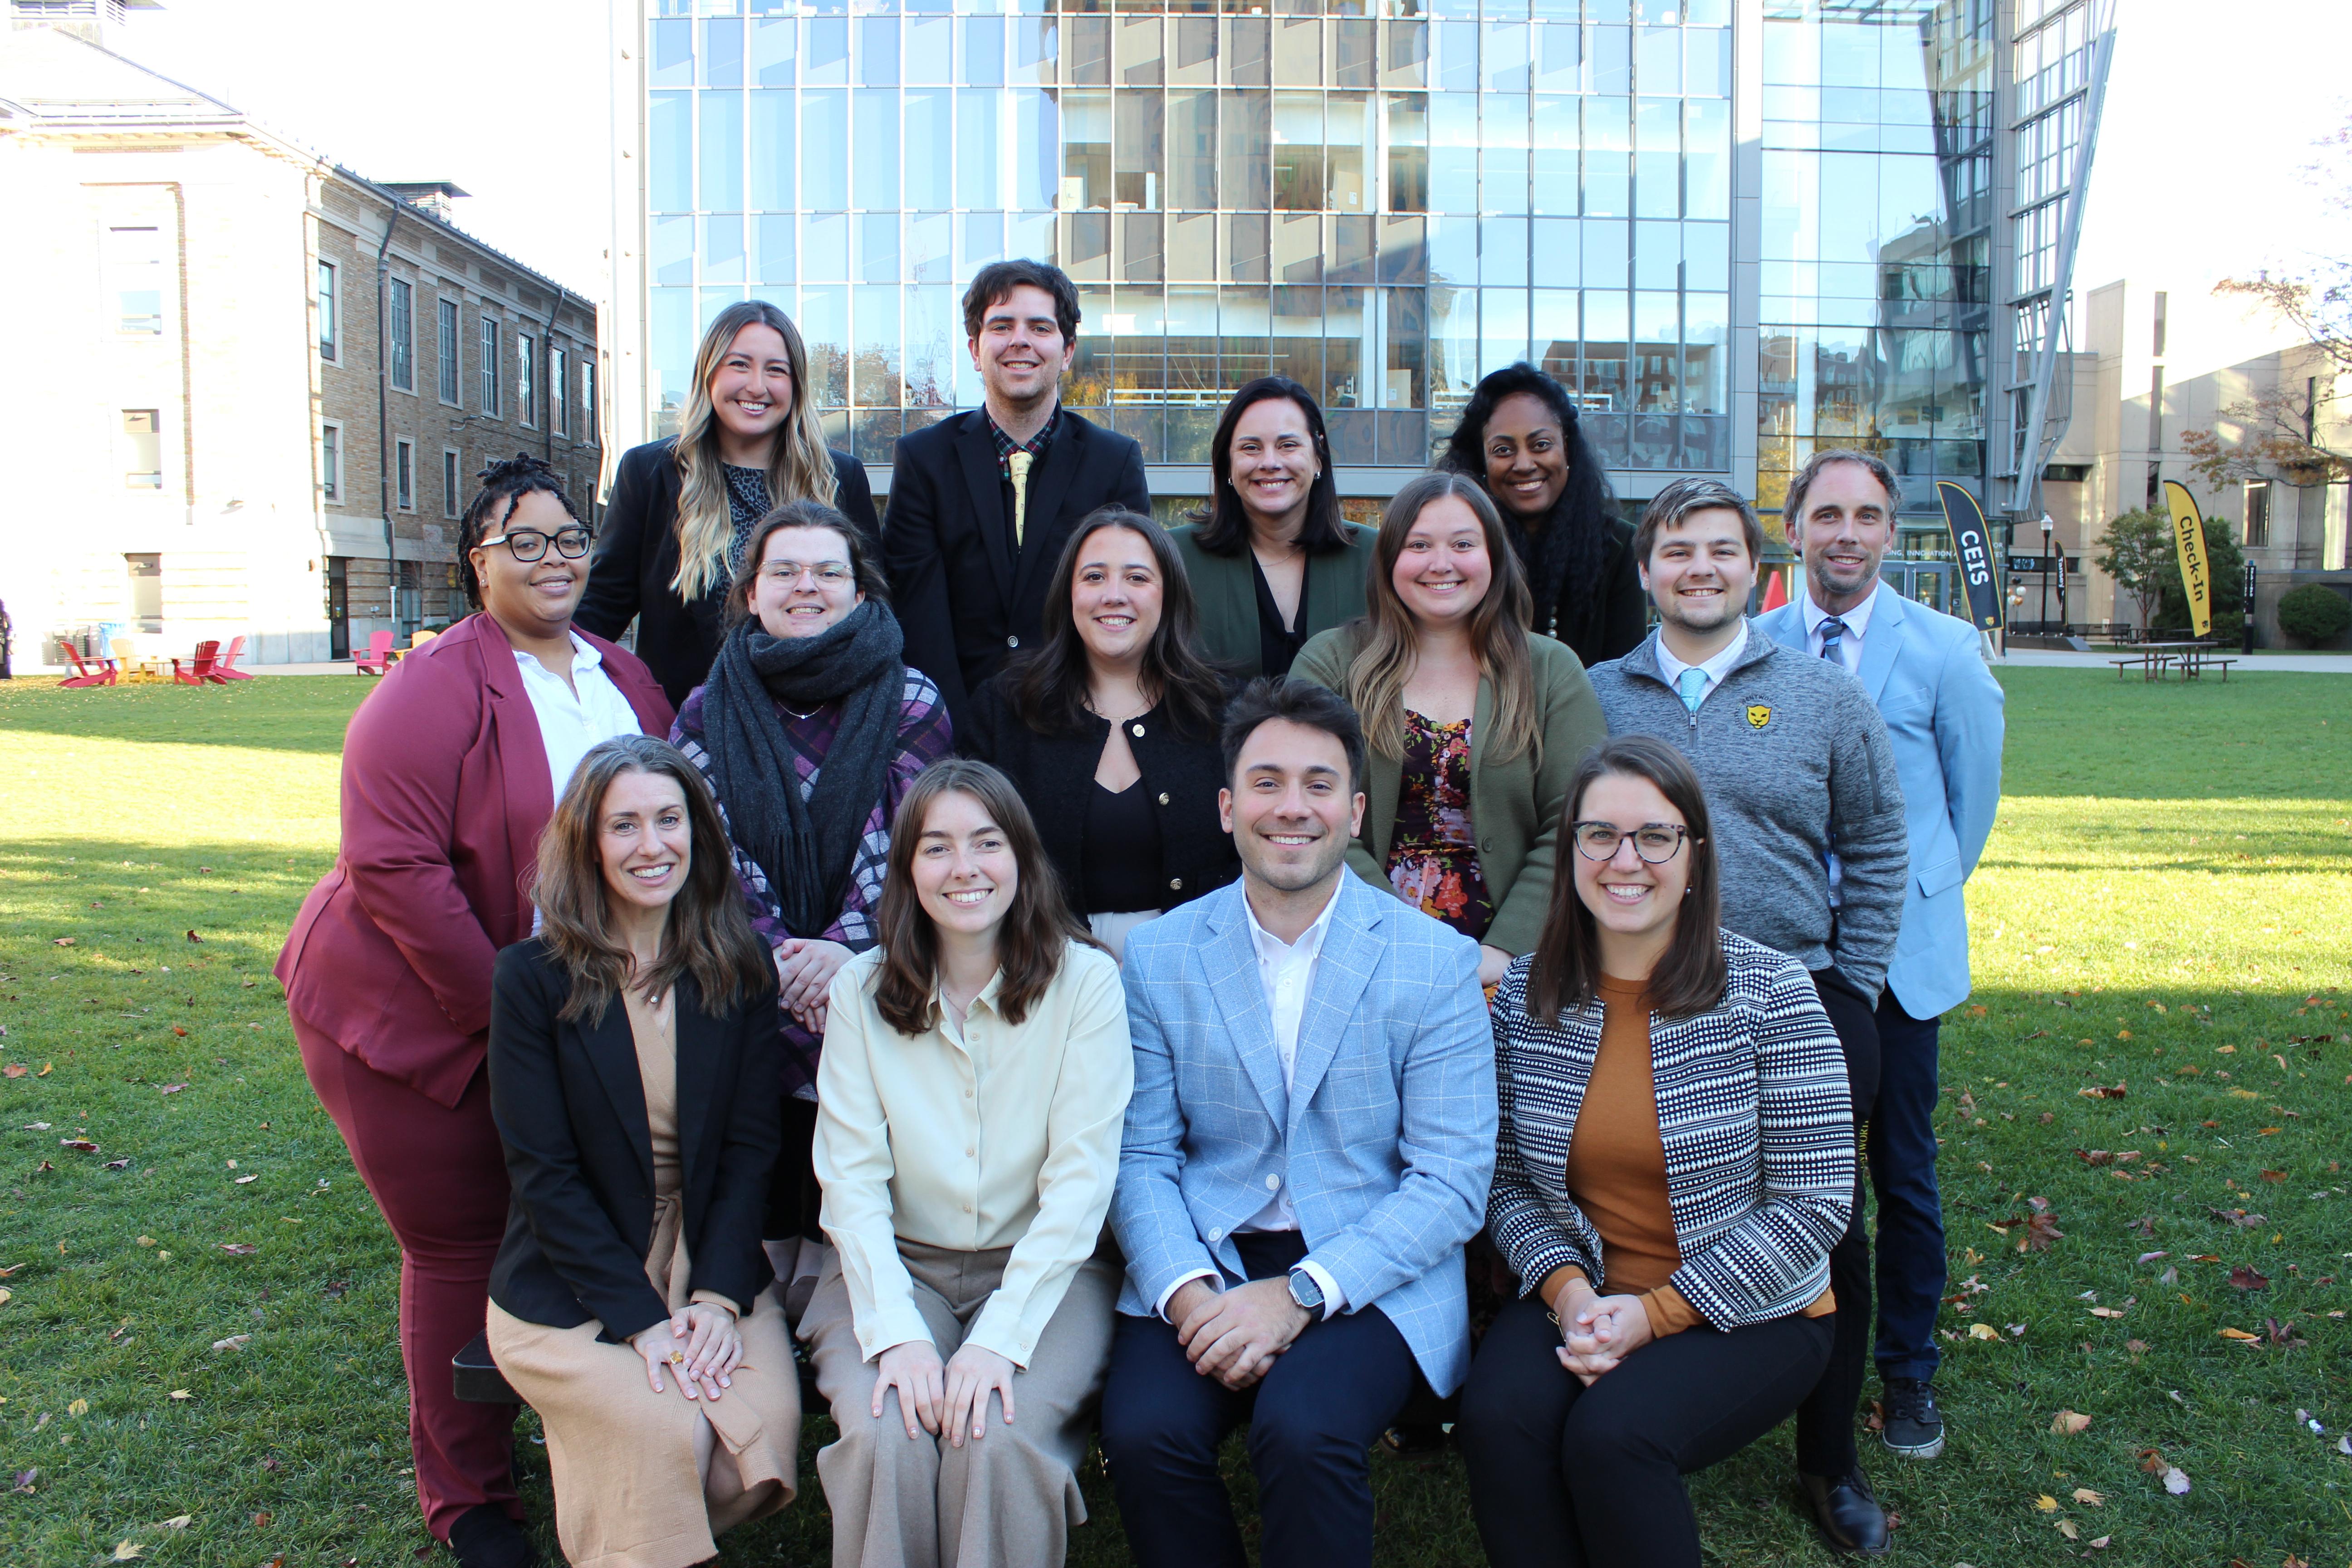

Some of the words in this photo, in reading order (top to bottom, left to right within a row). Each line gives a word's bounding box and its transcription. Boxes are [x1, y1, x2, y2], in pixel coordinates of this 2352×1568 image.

[1961, 530, 1989, 585] CEIS
[2180, 516, 2204, 602] Check-In
[1741, 694, 1779, 707] WENTWORTH
